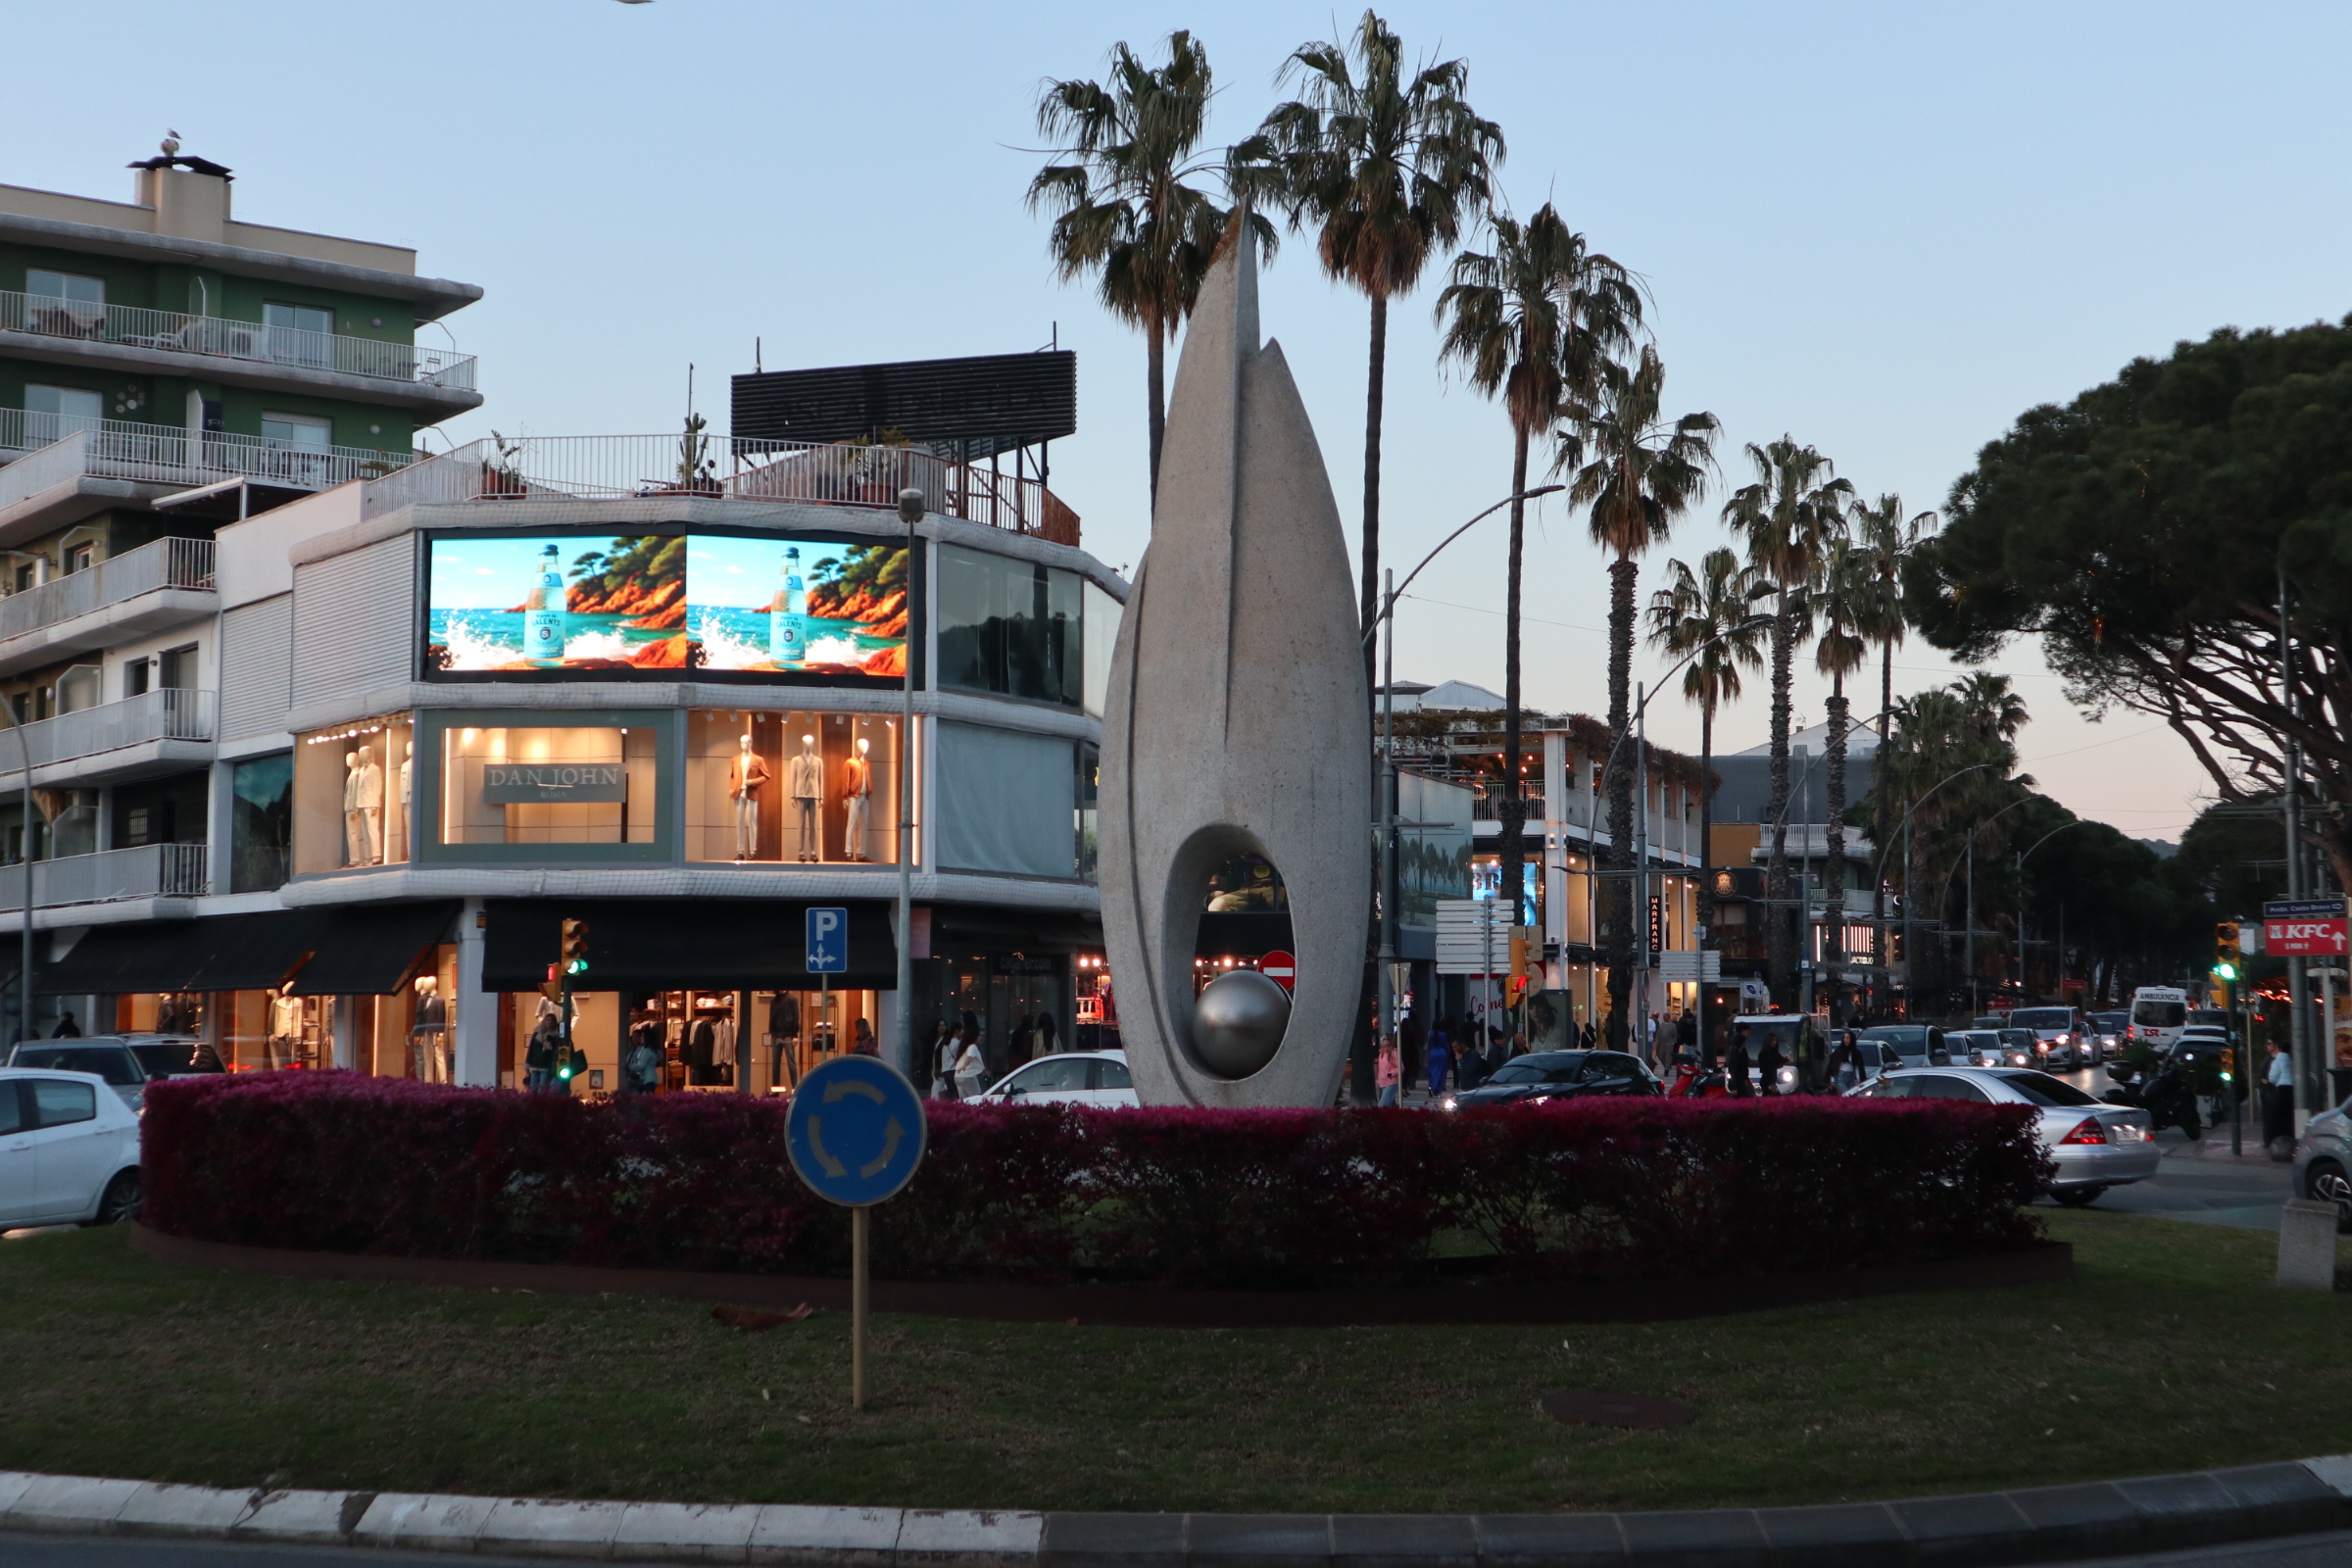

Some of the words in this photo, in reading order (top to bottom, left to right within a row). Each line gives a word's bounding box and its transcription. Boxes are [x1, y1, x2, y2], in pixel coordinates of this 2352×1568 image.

[776, 620, 802, 629] SALENYS
[489, 769, 544, 786] DAN
[552, 768, 618, 790] JOHN
[816, 911, 838, 941] P
[2285, 923, 2330, 939] KFC
